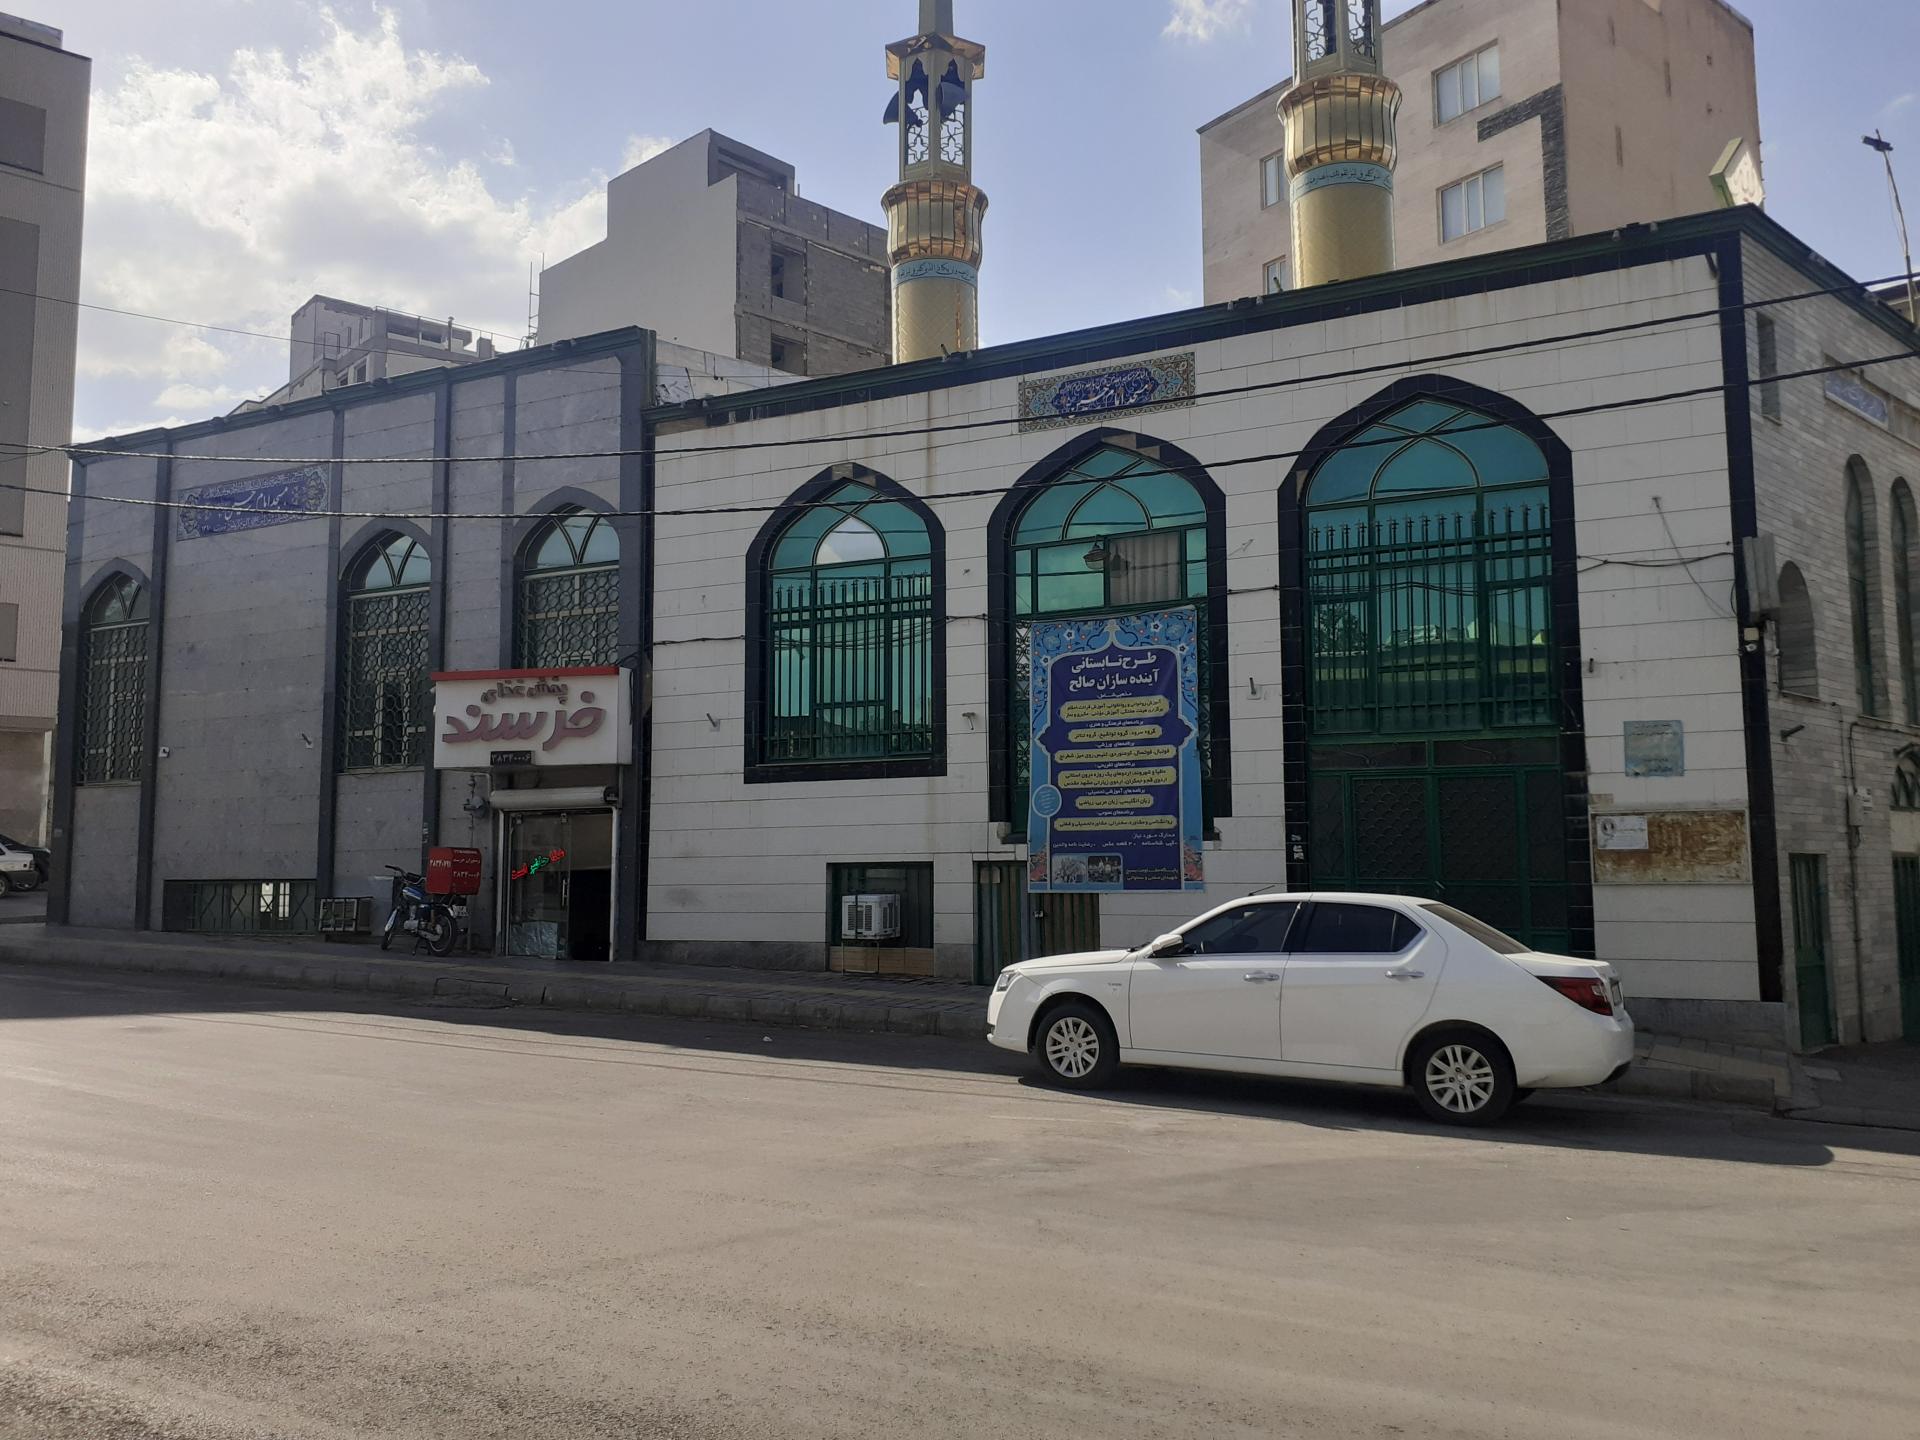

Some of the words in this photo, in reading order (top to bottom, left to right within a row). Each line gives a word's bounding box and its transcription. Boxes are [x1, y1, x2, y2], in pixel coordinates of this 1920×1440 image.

[1071, 654, 1122, 674] تابستانی
[1121, 651, 1157, 670] طرح
[1069, 675, 1095, 693] صالح
[1096, 672, 1128, 691] سازان
[1129, 668, 1160, 687] آینده
[481, 679, 526, 704] غذای
[442, 691, 606, 751] خرسند
